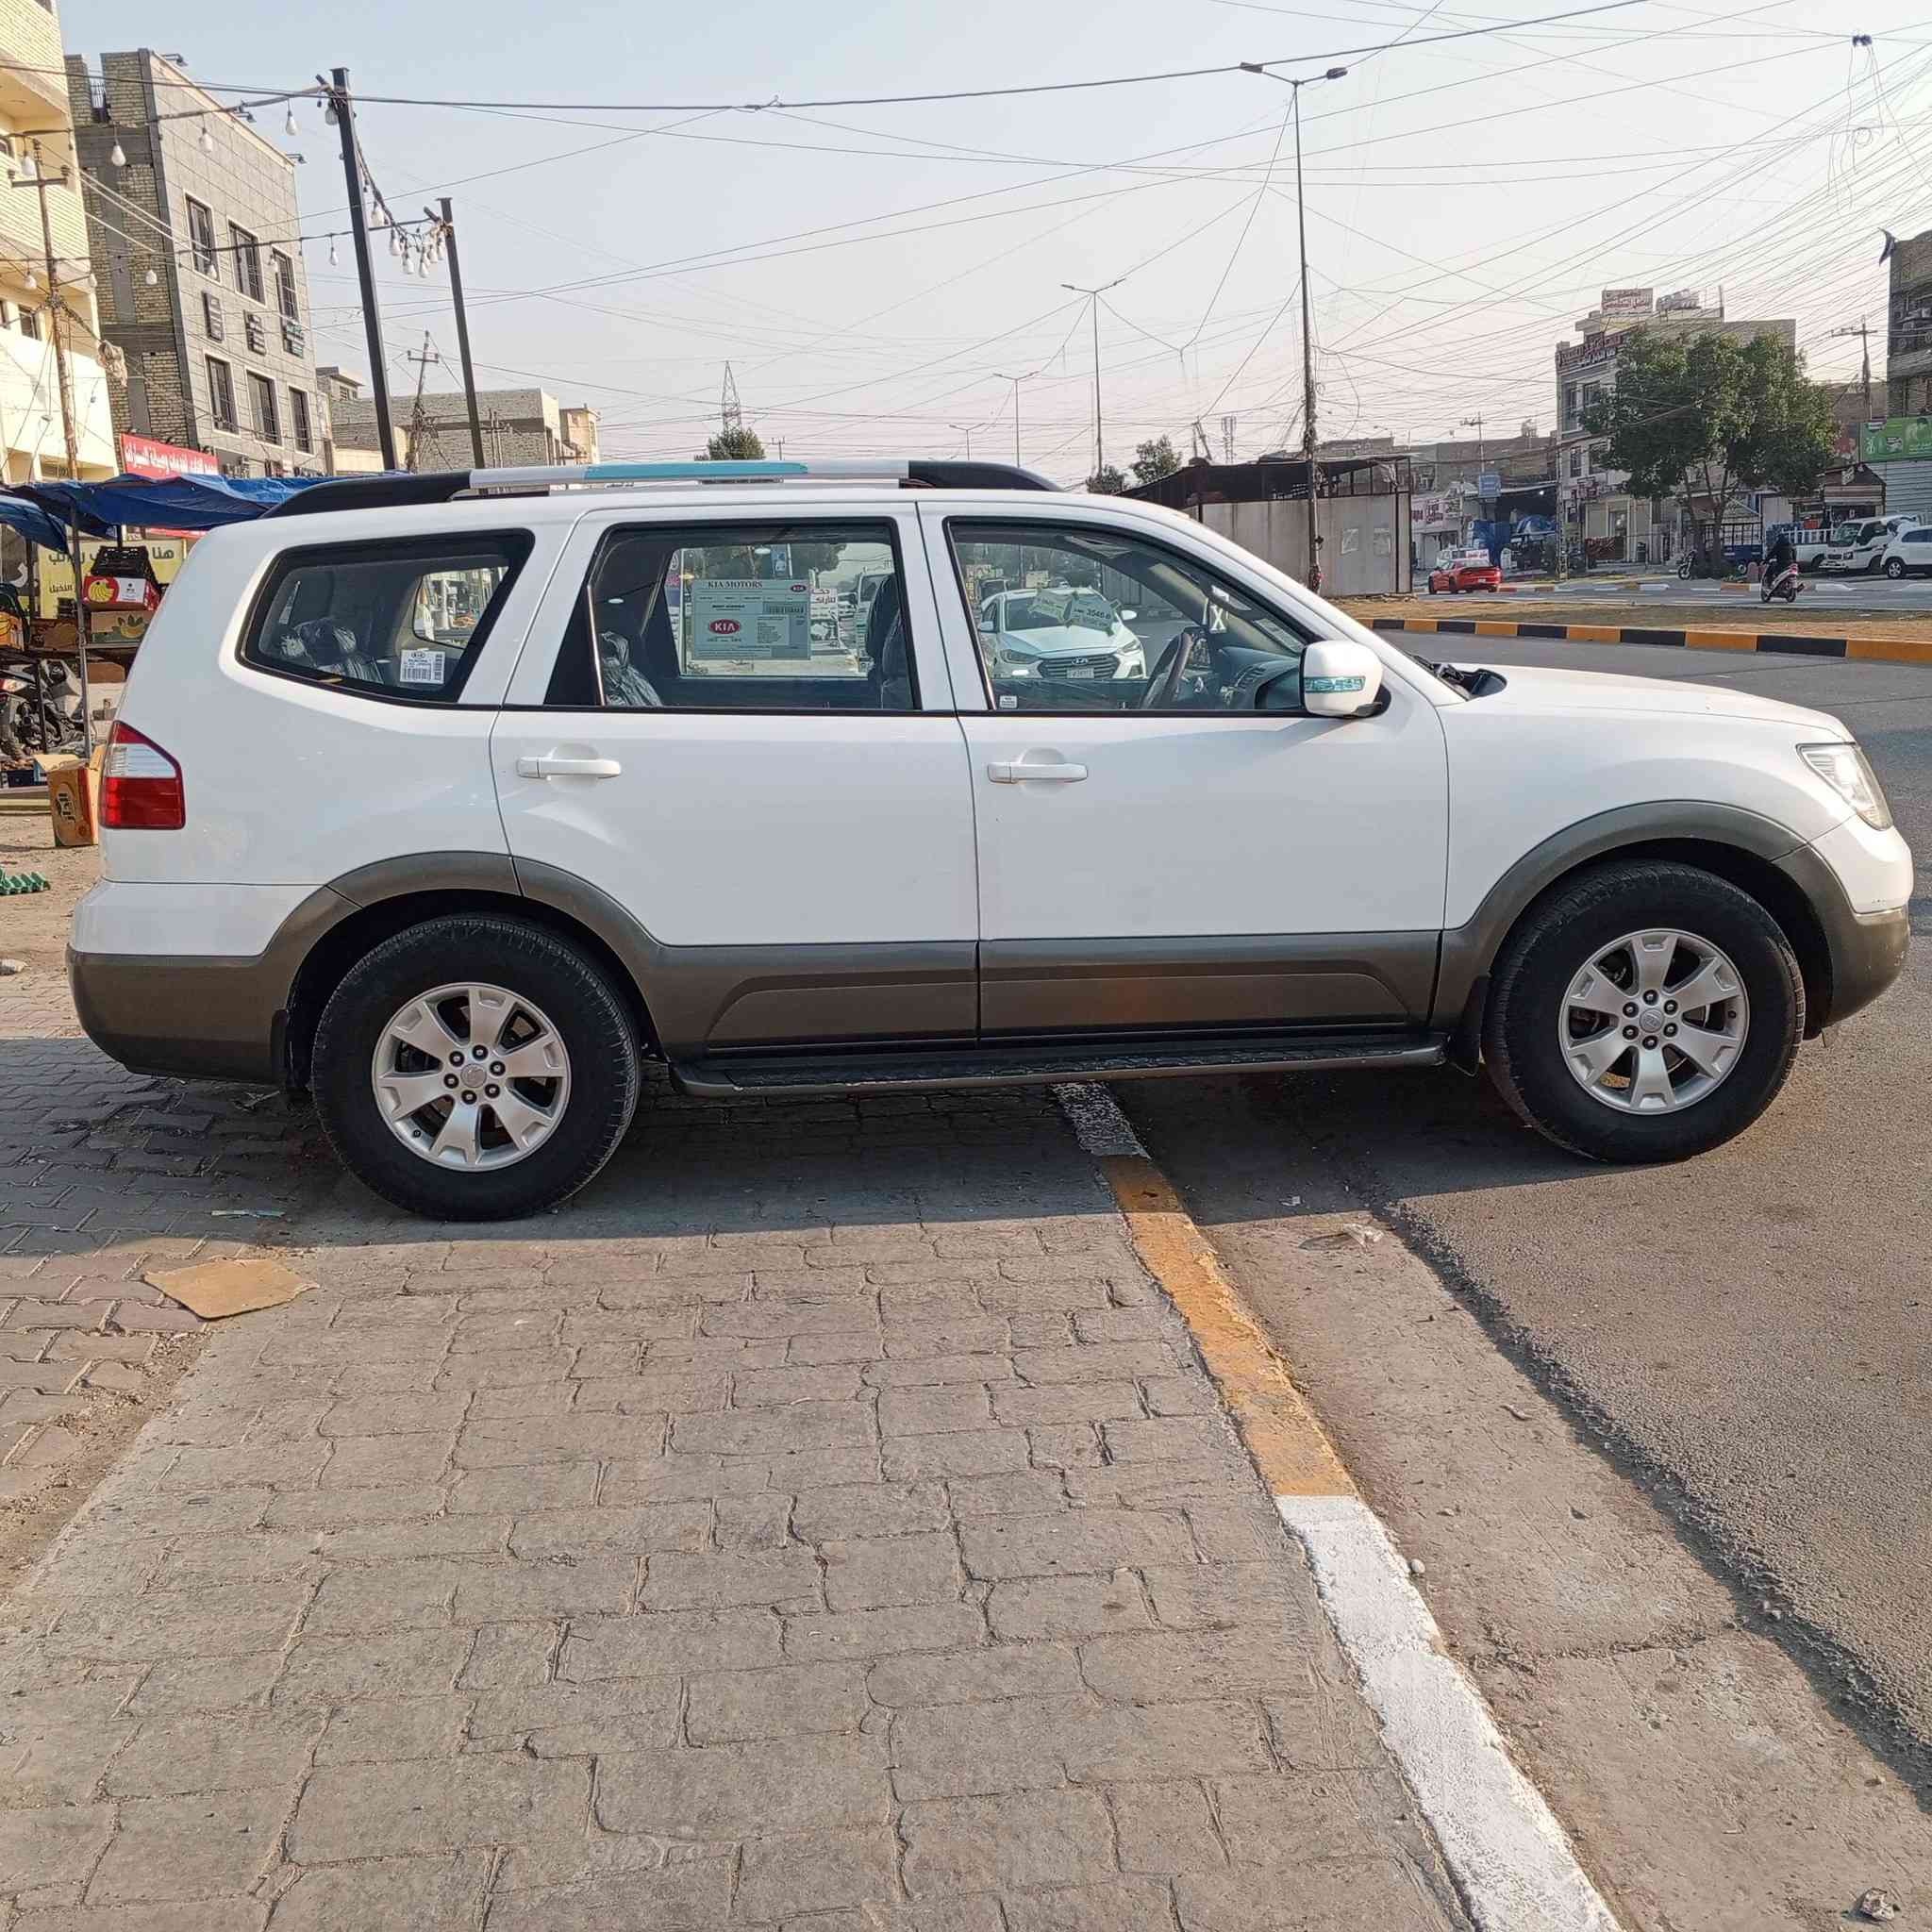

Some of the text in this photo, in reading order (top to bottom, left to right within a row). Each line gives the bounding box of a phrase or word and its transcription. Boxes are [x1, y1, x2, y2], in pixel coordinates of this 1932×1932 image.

[152, 546, 175, 559] هنا
[708, 580, 763, 590] KIA MOTORS
[715, 623, 736, 631] KIA
